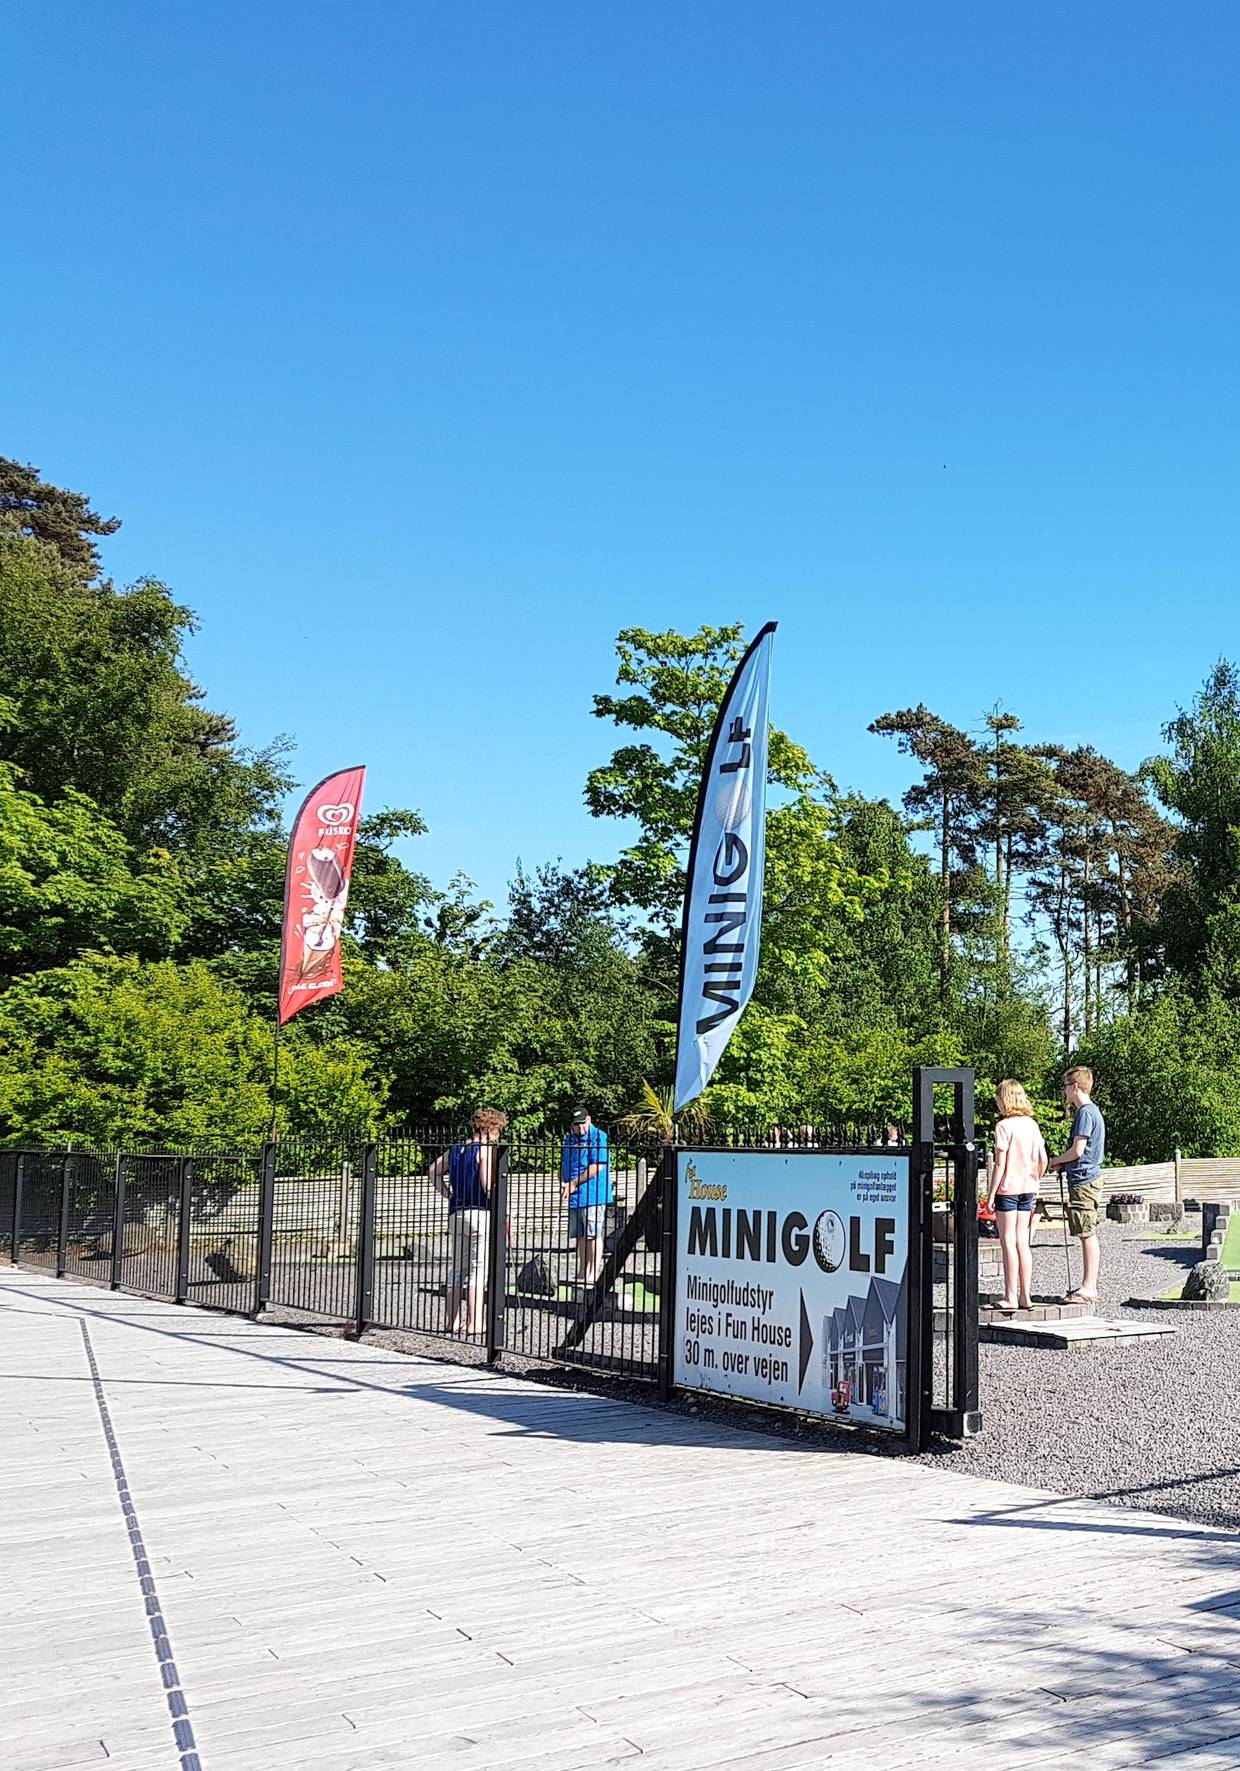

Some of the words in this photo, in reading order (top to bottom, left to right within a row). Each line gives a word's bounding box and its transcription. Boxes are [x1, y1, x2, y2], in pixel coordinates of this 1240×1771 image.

[696, 716, 752, 1035] MINIGOLF
[688, 1179, 728, 1201] House
[687, 1206, 896, 1274] MINIGOLF
[687, 1274, 774, 1315] Minigolfudstyr
[686, 1306, 714, 1339] lejes
[717, 1311, 722, 1337] i
[725, 1312, 747, 1341] Fun
[751, 1316, 792, 1348] House
[685, 1339, 700, 1366] 30
[703, 1347, 718, 1370] m.
[722, 1351, 750, 1375] over
[753, 1352, 788, 1385] vejen
